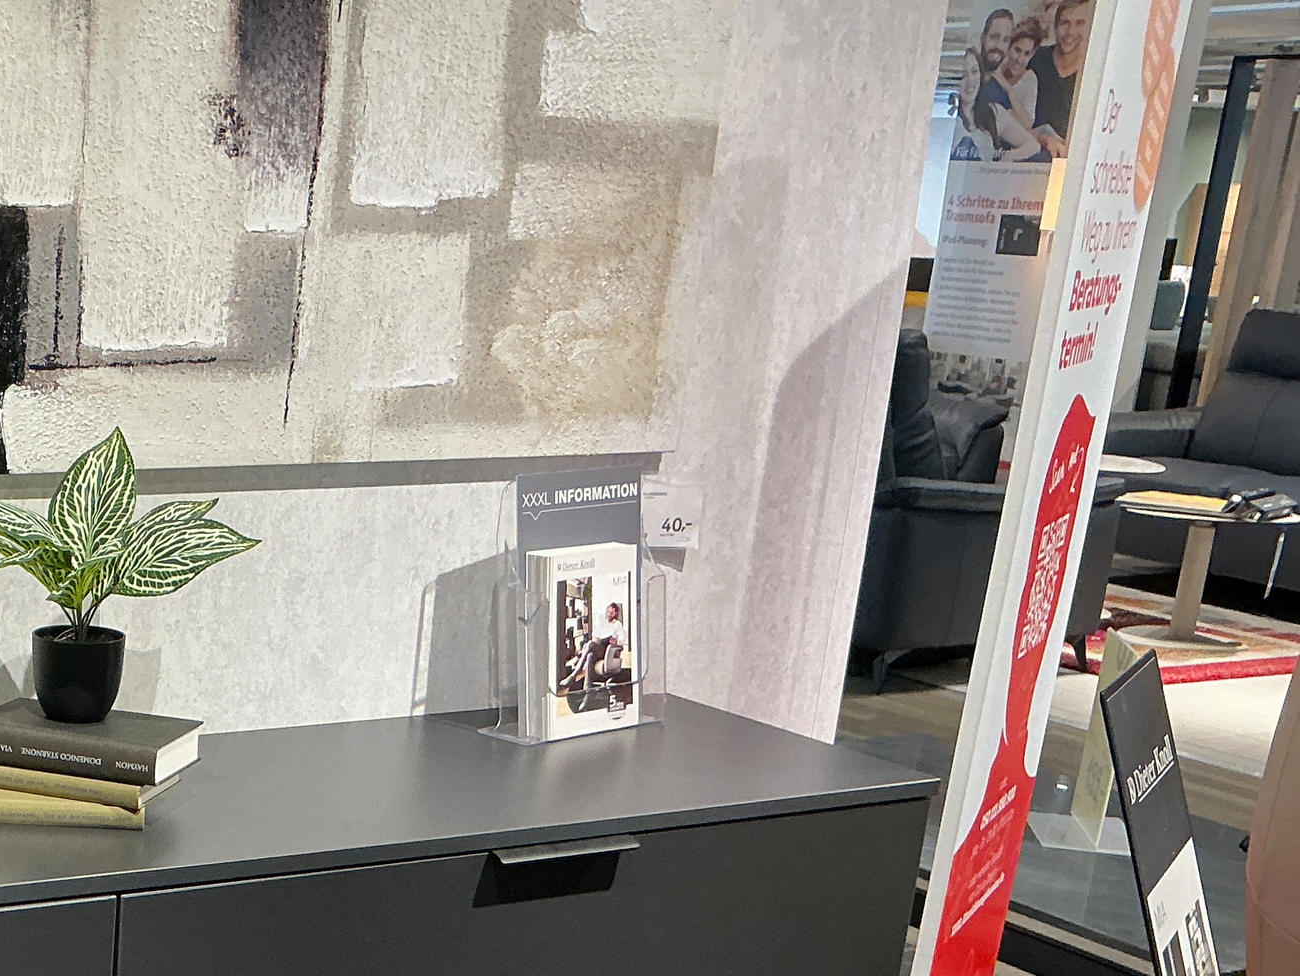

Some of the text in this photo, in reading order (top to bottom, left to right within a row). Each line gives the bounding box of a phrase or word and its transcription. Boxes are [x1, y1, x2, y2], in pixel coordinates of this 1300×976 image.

[1102, 88, 1122, 134] Der
[956, 194, 996, 209] Schritte
[997, 199, 1009, 210] zu
[947, 209, 995, 224] Traumsofa
[1080, 210, 1102, 264] Weg
[1069, 268, 1122, 316] Beratungs-
[1059, 321, 1098, 370] termin!
[522, 492, 552, 508] XXXL
[554, 482, 638, 505] INFORMATION
[661, 517, 693, 533] 40,-
[0, 744, 13, 753] VIA
[21, 746, 60, 761] STARNONE
[59, 752, 102, 766] DOMENICO
[115, 760, 149, 773] HAYMON
[1133, 733, 1174, 798] Dieter Knoll
